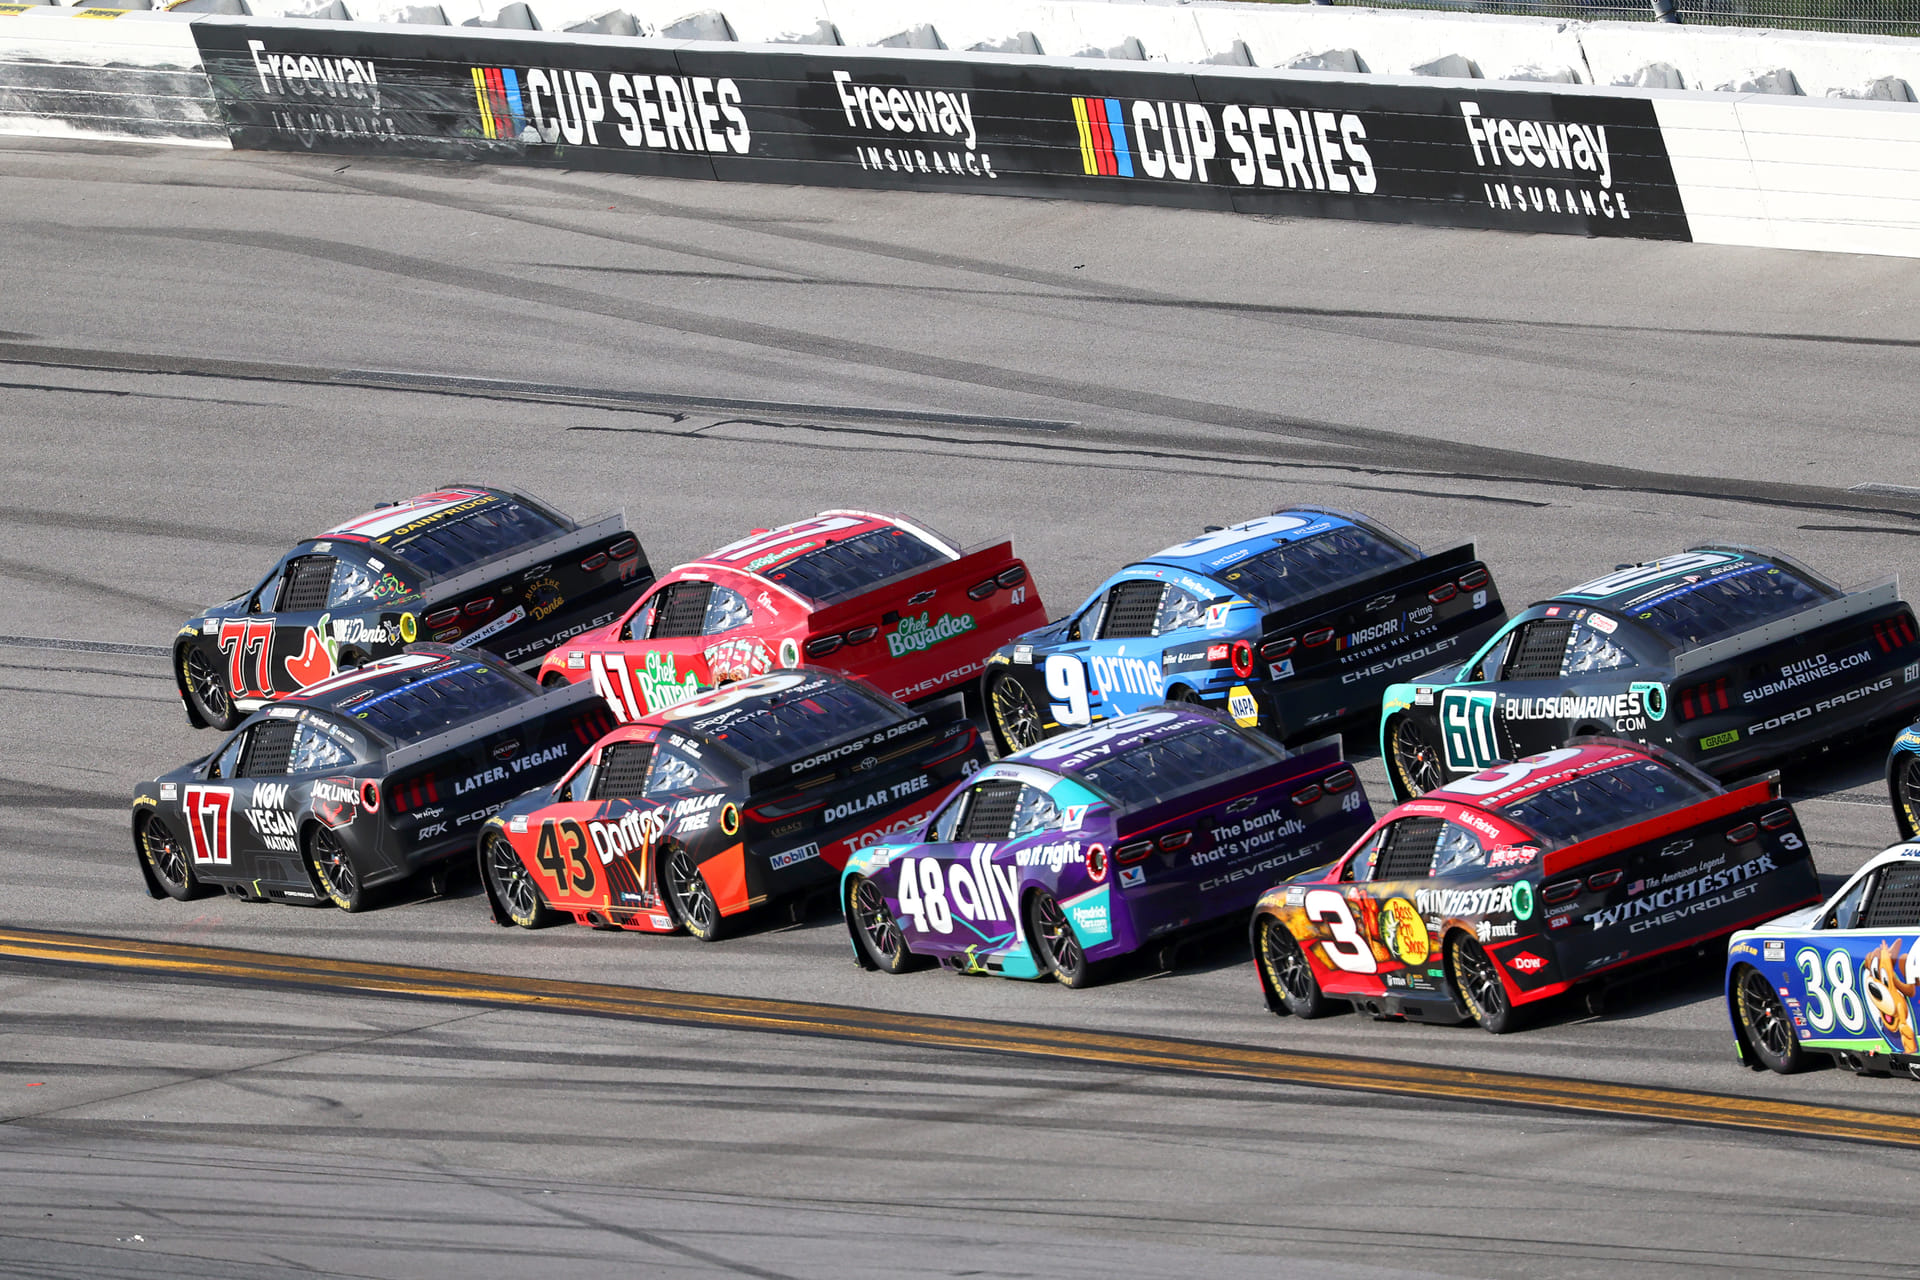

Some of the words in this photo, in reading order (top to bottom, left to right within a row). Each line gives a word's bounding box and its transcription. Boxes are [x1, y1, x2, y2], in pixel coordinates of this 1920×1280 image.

[248, 40, 381, 116] Freeway
[525, 68, 606, 146] CUP
[608, 73, 752, 155] SERIES
[832, 70, 977, 150] Freeway
[1131, 100, 1217, 182] CUP
[1222, 103, 1378, 194] SERIES
[1460, 101, 1612, 188] Freeway
[856, 146, 998, 180] INSURANCE
[1483, 183, 1631, 220] INSURANCE
[618, 558, 638, 581] 77
[1211, 548, 1250, 568] prime
[529, 596, 565, 621] Dente
[1011, 586, 1025, 606] 47
[1473, 590, 1487, 609] 9
[350, 618, 387, 643] Dente
[482, 625, 497, 637] ME
[505, 612, 614, 660] CHEVROLET
[887, 613, 973, 657] Boyardee
[899, 612, 929, 637] Chef
[1351, 619, 1398, 647] NASCAR
[1409, 604, 1433, 622] prime
[218, 617, 277, 699] 77
[1340, 646, 1387, 664] RETURNS
[1391, 635, 1410, 647] MAY
[1414, 625, 1438, 639] 2026
[1341, 635, 1460, 685] CHEVROLET
[646, 652, 676, 685] Chef
[892, 653, 998, 699] CHEVROL
[1091, 645, 1164, 702] prime
[1742, 650, 1872, 704] SUBMARINES.COM
[1781, 653, 1828, 678] BUILD
[1904, 664, 1919, 683] 60
[590, 653, 642, 723] 47
[1046, 654, 1092, 728] 9
[1231, 696, 1256, 719] NAPA
[1505, 693, 1641, 720] BUILDSUBMARINES
[1748, 707, 1812, 735] FORD
[1816, 678, 1894, 712] RACING
[873, 731, 885, 744] &
[887, 717, 929, 739] DEGA
[1440, 689, 1501, 772] 60
[1612, 716, 1647, 733] .COM
[1705, 734, 1735, 748] GRAZA
[1060, 744, 1112, 768] ally
[1156, 718, 1204, 734] right.
[454, 766, 510, 796] LATER,
[510, 743, 568, 774] VEGAN!
[961, 759, 981, 777] 43
[253, 783, 288, 809] NON
[310, 779, 332, 801] JACK
[675, 794, 726, 818] DOLLAR
[824, 790, 889, 824] DOLLAR
[890, 774, 929, 800] TREE
[1341, 791, 1361, 813] 48
[183, 785, 234, 865] 17
[245, 809, 298, 836] VEGAN
[418, 821, 448, 841] RFK
[588, 805, 667, 866] Doritos
[677, 811, 711, 833] TREE
[1211, 826, 1241, 843] The
[1243, 809, 1282, 834] bank
[1459, 810, 1477, 827] Huk
[1473, 818, 1500, 839] Fishing
[263, 836, 298, 852] NATION
[535, 817, 597, 898] 43
[772, 848, 806, 869] Mobil
[807, 843, 818, 856] 1
[1042, 840, 1085, 873] right.
[1191, 844, 1239, 867] that's
[1240, 830, 1276, 854] your
[1277, 817, 1306, 839] ally.
[1779, 832, 1803, 851] 3
[1200, 841, 1324, 892] CHEVROLET
[1645, 873, 1660, 889] The
[1661, 860, 1701, 885] American
[1698, 853, 1727, 876] Legend
[898, 857, 954, 935] 48
[948, 842, 1025, 942] ally
[1415, 886, 1513, 916] WINCHESTER
[1583, 853, 1779, 932] WINCHESTER
[1630, 882, 1760, 934] CHEVROLET
[1073, 905, 1107, 923] Hendrick
[1393, 901, 1414, 921] Bass
[1549, 902, 1580, 916] OKUMA
[1551, 916, 1569, 928] SEM
[1305, 889, 1378, 976] 3
[1400, 919, 1415, 938] Pro
[1404, 938, 1428, 958] Shops
[1729, 942, 1759, 956] GOODYEAR
[1796, 947, 1866, 1035] 38
